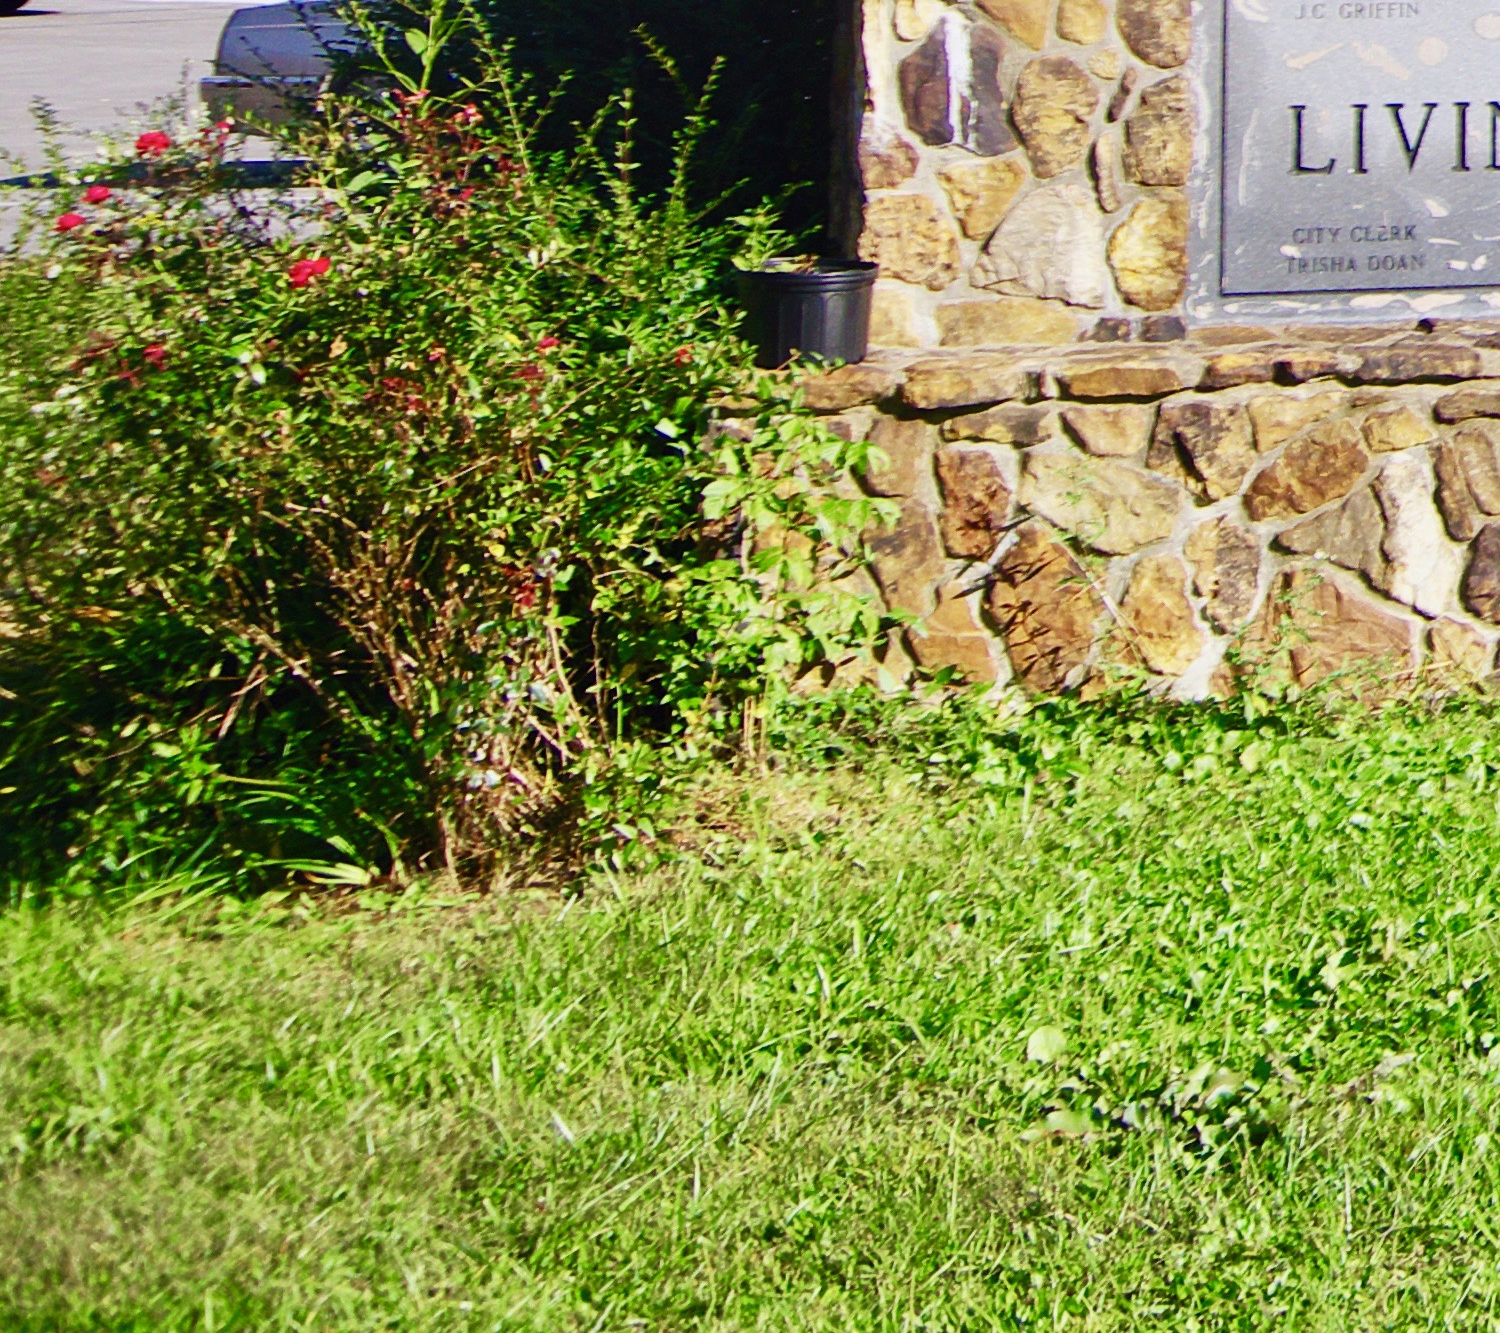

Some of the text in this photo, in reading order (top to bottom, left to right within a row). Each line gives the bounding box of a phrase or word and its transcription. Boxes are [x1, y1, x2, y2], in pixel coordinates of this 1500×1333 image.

[1338, 1, 1419, 20] GRIFFIN
[1292, 224, 1417, 244] CITY CLERK
[1367, 253, 1425, 271] DOAN
